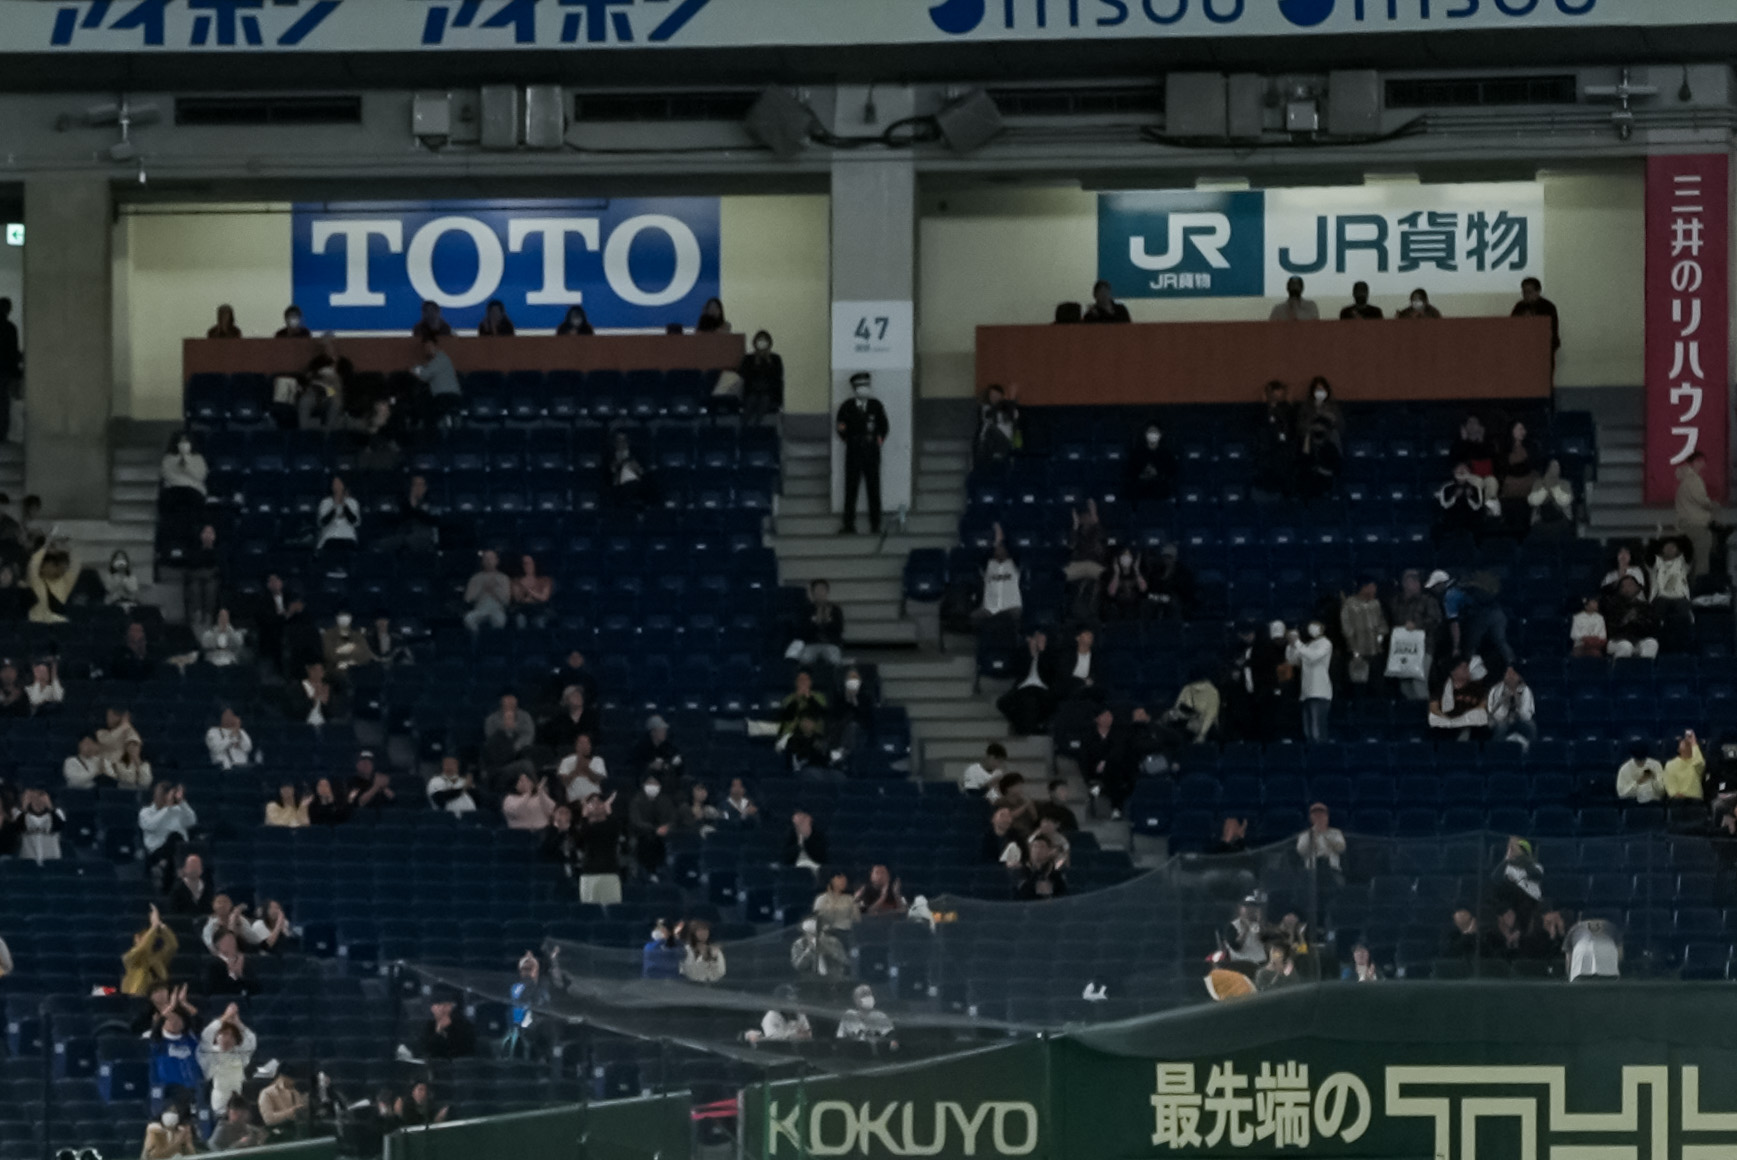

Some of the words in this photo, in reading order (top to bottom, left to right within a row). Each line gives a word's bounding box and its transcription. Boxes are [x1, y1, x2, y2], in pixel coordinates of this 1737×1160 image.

[311, 213, 702, 309] TOTO
[1129, 211, 1232, 271] JR
[1278, 210, 1529, 275] JR貨物
[854, 316, 890, 341] 47
[768, 1100, 1039, 1156] KOKUYO
[1151, 1059, 1372, 1149] 最先端の
